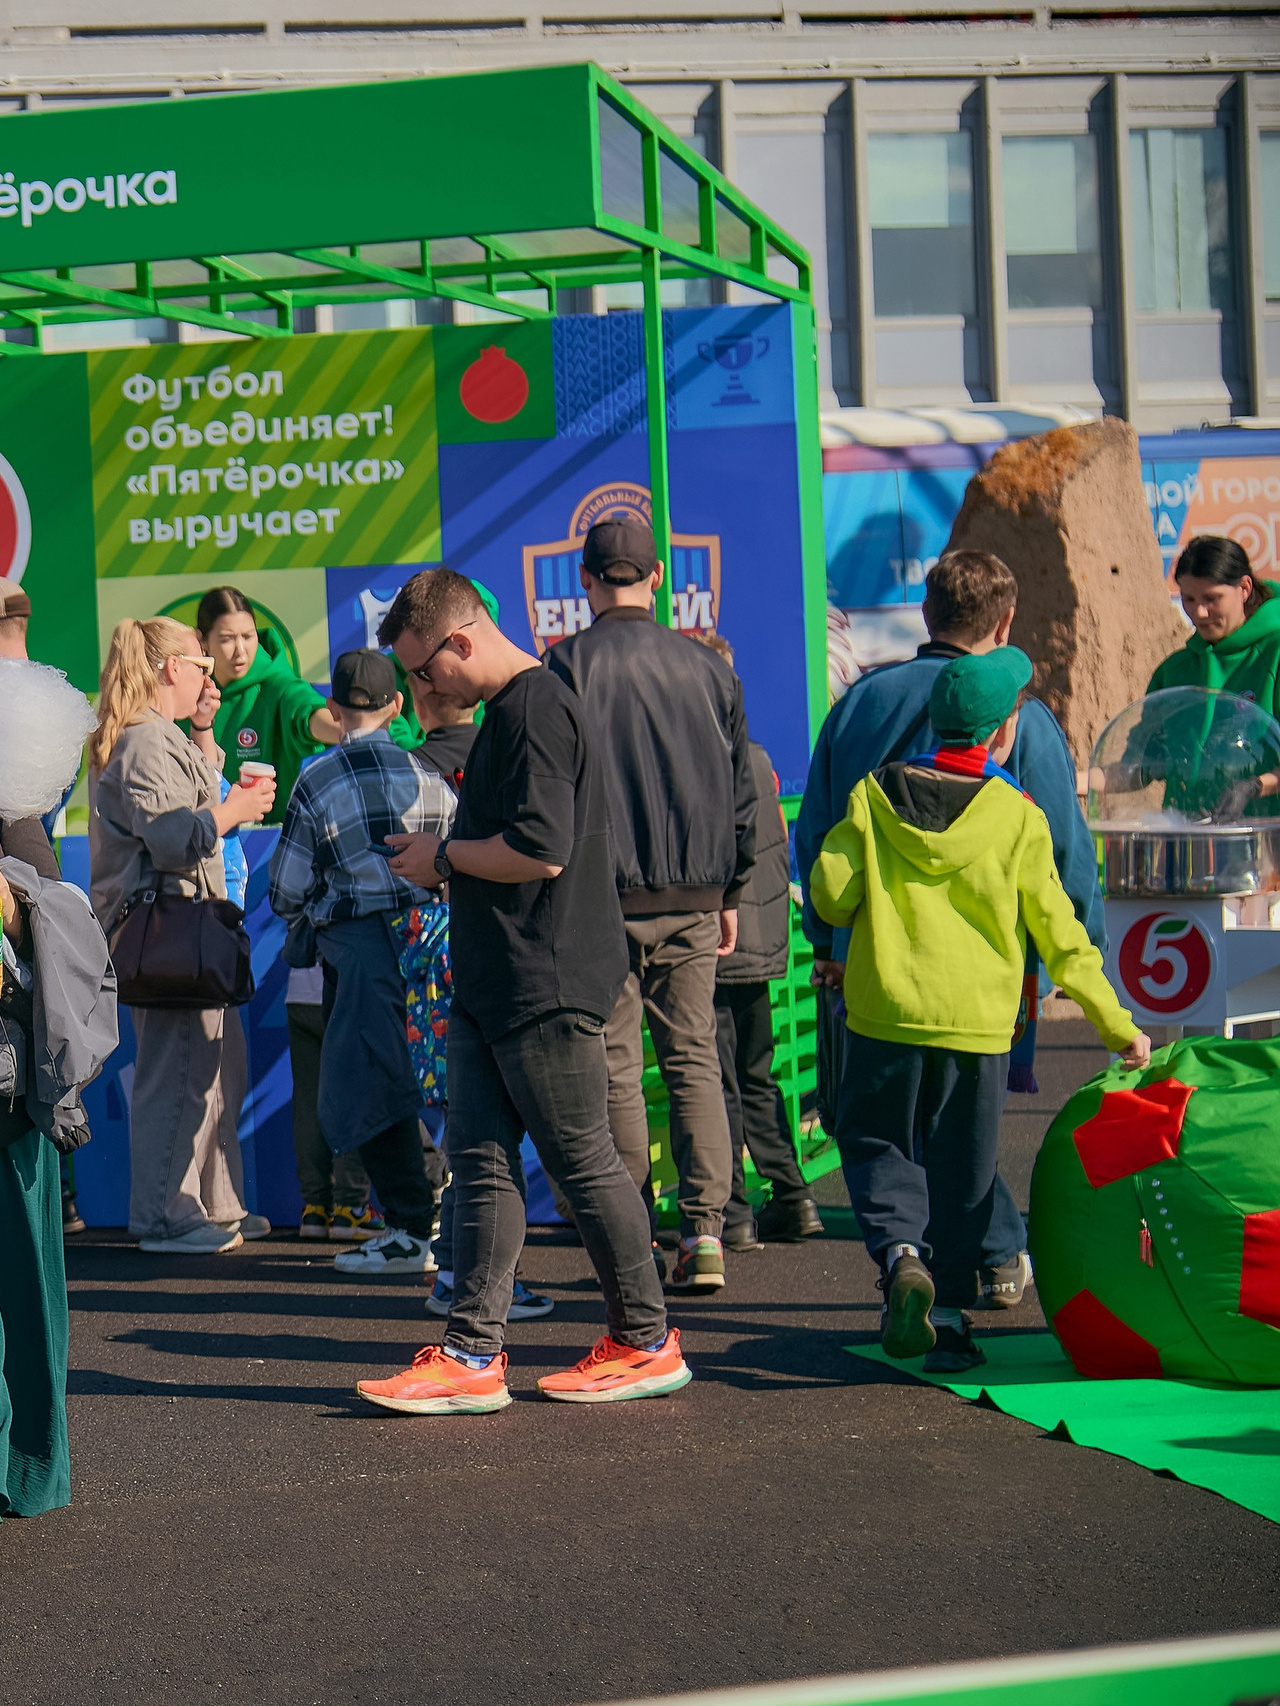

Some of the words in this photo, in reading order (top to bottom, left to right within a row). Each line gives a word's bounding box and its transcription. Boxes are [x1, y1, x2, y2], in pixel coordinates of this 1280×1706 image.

[121, 364, 284, 411] Футбол
[125, 404, 394, 452] объединяет!
[126, 456, 406, 498] «Пятёрочка»
[1143, 472, 1205, 508] ВОЙ
[1212, 475, 1280, 505] ГОРО
[129, 507, 341, 549] выручает
[1140, 913, 1193, 1000] 5
